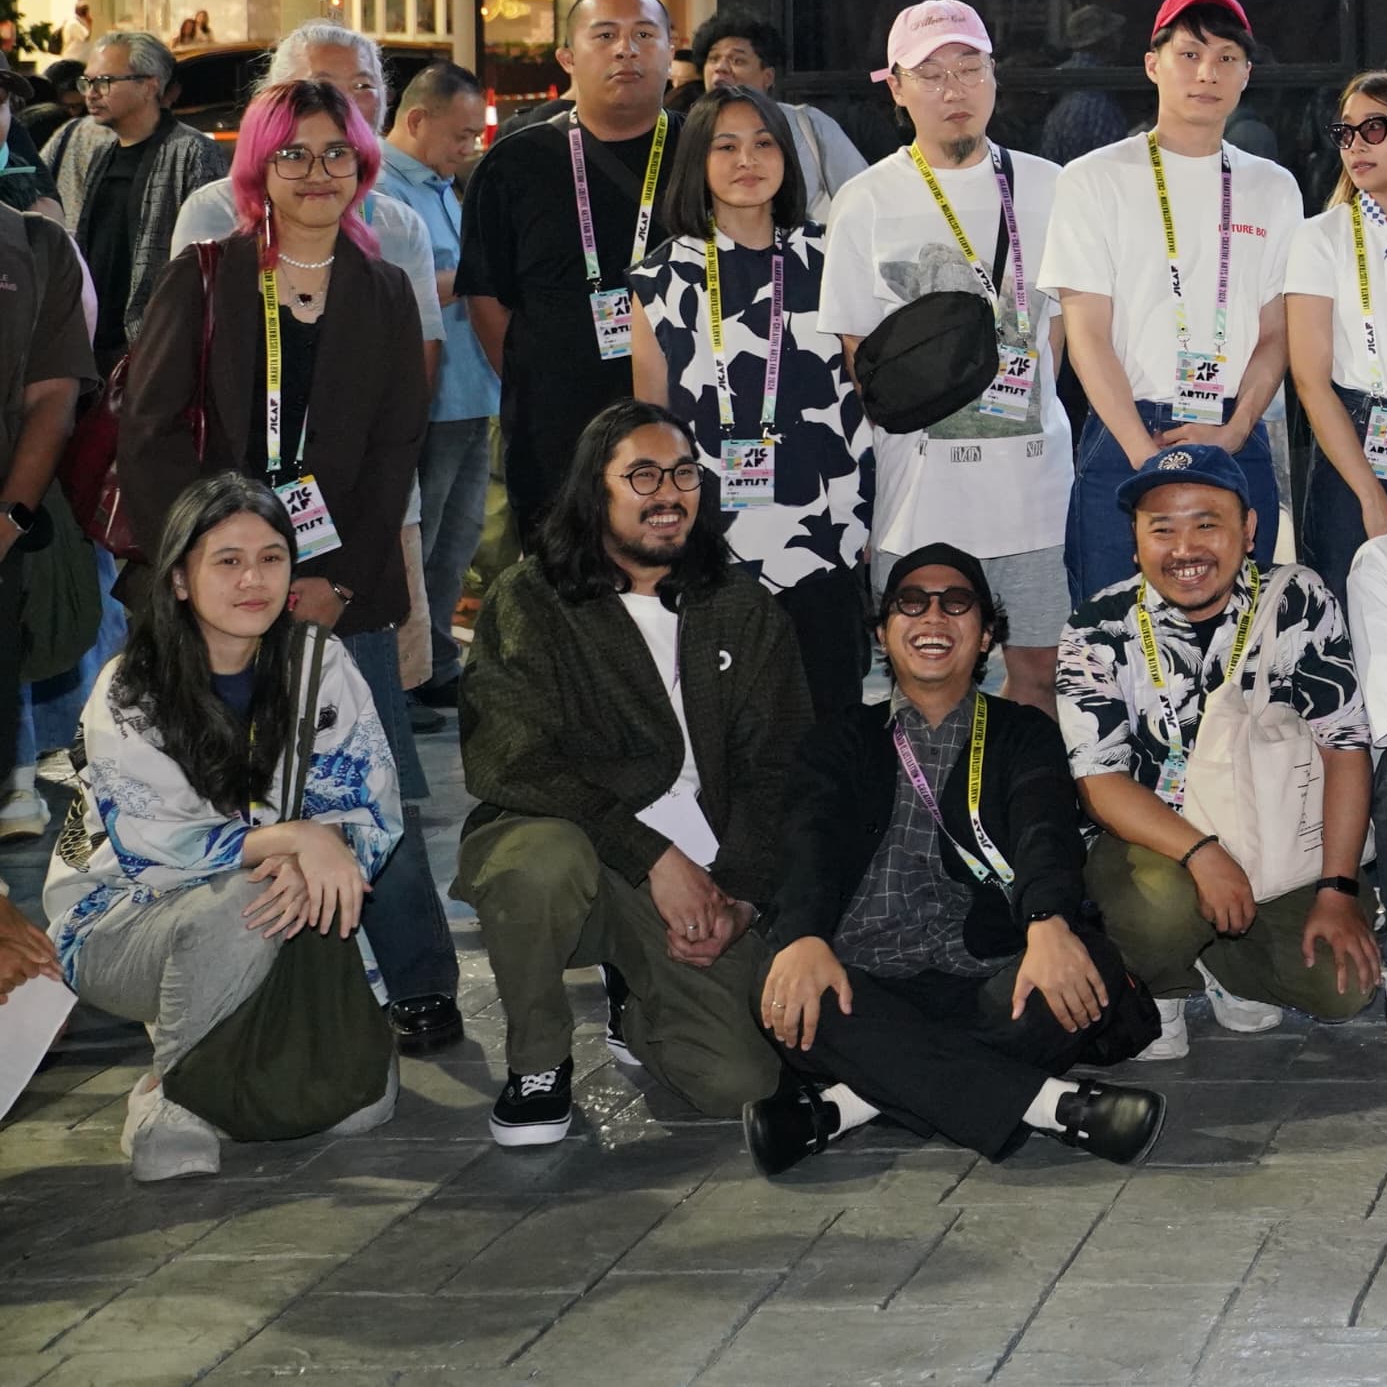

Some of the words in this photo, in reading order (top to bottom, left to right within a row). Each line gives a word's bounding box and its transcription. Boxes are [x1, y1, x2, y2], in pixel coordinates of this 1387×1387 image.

[638, 212, 649, 241] JICAF
[974, 267, 995, 294] JICAF
[1170, 265, 1182, 297] JICAF
[1218, 291, 1227, 303] 2024
[1365, 323, 1376, 354] JICAF
[1010, 357, 1031, 369] JIC
[1197, 361, 1219, 372] JIC
[716, 360, 727, 391] JICAF
[1008, 367, 1027, 377] AF
[1196, 372, 1216, 382] AF
[990, 384, 1026, 397] ARTIST
[1180, 389, 1218, 401] ARTIST
[270, 398, 279, 434] JICAF
[745, 448, 768, 458] JIC
[744, 458, 765, 468] AF
[728, 478, 769, 487] ARTIST
[287, 486, 312, 504] JIC
[290, 498, 310, 515] AF
[1160, 695, 1177, 728] JICAF
